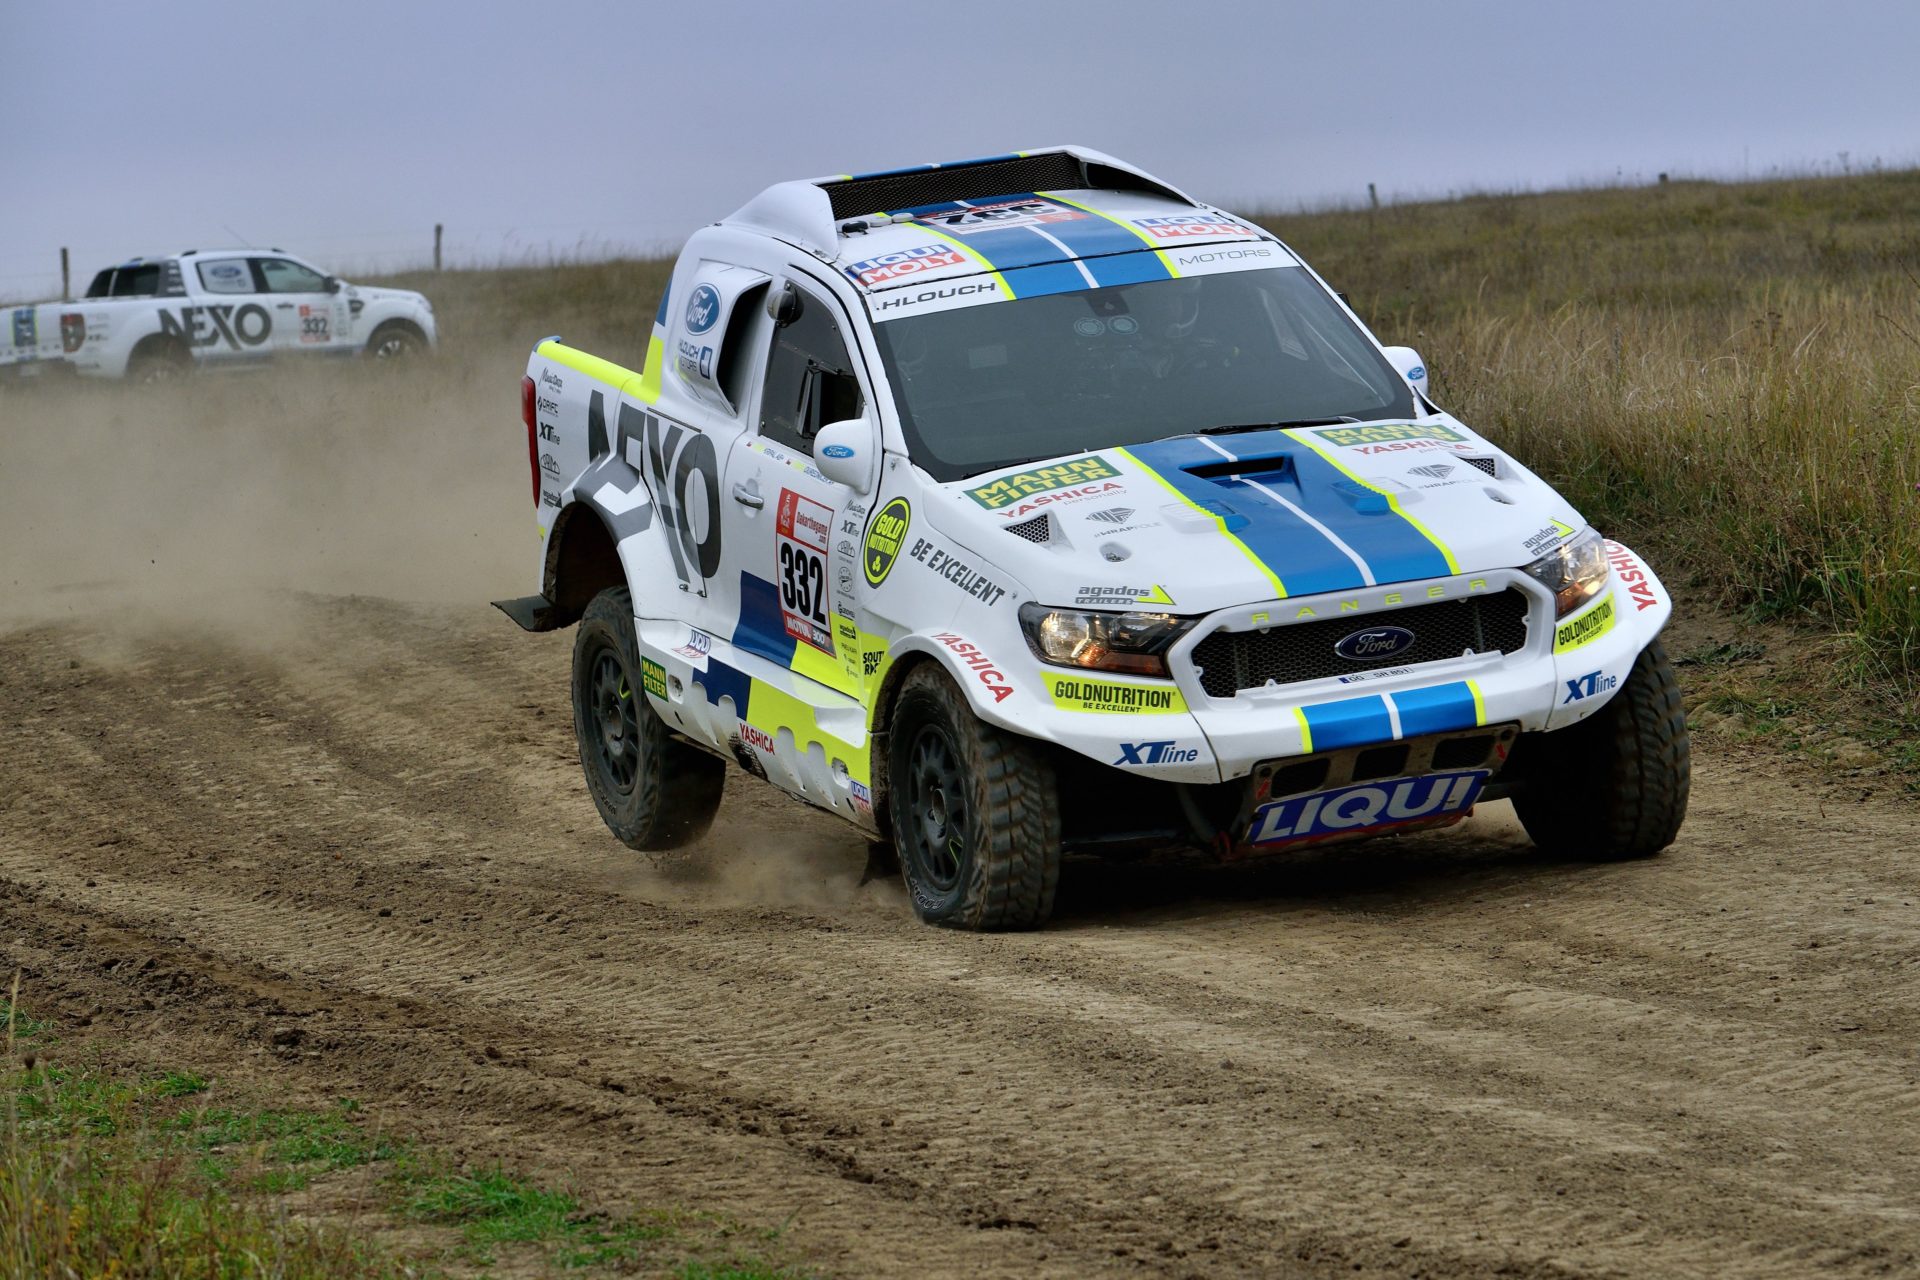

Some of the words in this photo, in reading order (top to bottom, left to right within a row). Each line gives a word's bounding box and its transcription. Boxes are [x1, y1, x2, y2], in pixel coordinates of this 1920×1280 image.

[1137, 216, 1235, 227] LIQUI
[1151, 224, 1250, 237] MOLY
[850, 244, 951, 272] LIQUI
[861, 252, 956, 283] MOLY
[1178, 249, 1272, 266] MOTORS
[686, 289, 713, 327] Ford
[882, 282, 996, 310] HLOUCH
[158, 303, 272, 351] NEXO
[302, 317, 329, 335] 332
[1352, 440, 1474, 455] YASHICA
[974, 458, 1101, 499] MANN
[984, 468, 1113, 508] FILTER
[996, 482, 1124, 518] YASHICA
[875, 513, 905, 541] GOLD
[780, 542, 827, 626] 332
[910, 537, 934, 562] BE
[927, 549, 1006, 607] EXCELLENT
[1078, 585, 1151, 597] agados
[1251, 578, 1488, 625] RANGER
[812, 629, 826, 645] 300
[1558, 603, 1613, 646] GOLDNUTRITION
[1355, 632, 1399, 656] Ford
[642, 660, 666, 682] MANN
[930, 632, 1015, 704] YASHICA
[643, 674, 667, 699] FILTER
[1055, 680, 1172, 709] GOLDNUTRITION
[1563, 669, 1617, 705] XTline
[1082, 701, 1093, 710] BE
[1095, 703, 1143, 714] EXCELLENT
[739, 722, 776, 756] YASHICA
[1112, 740, 1199, 766] XTline
[1254, 775, 1476, 842] LIQUI
